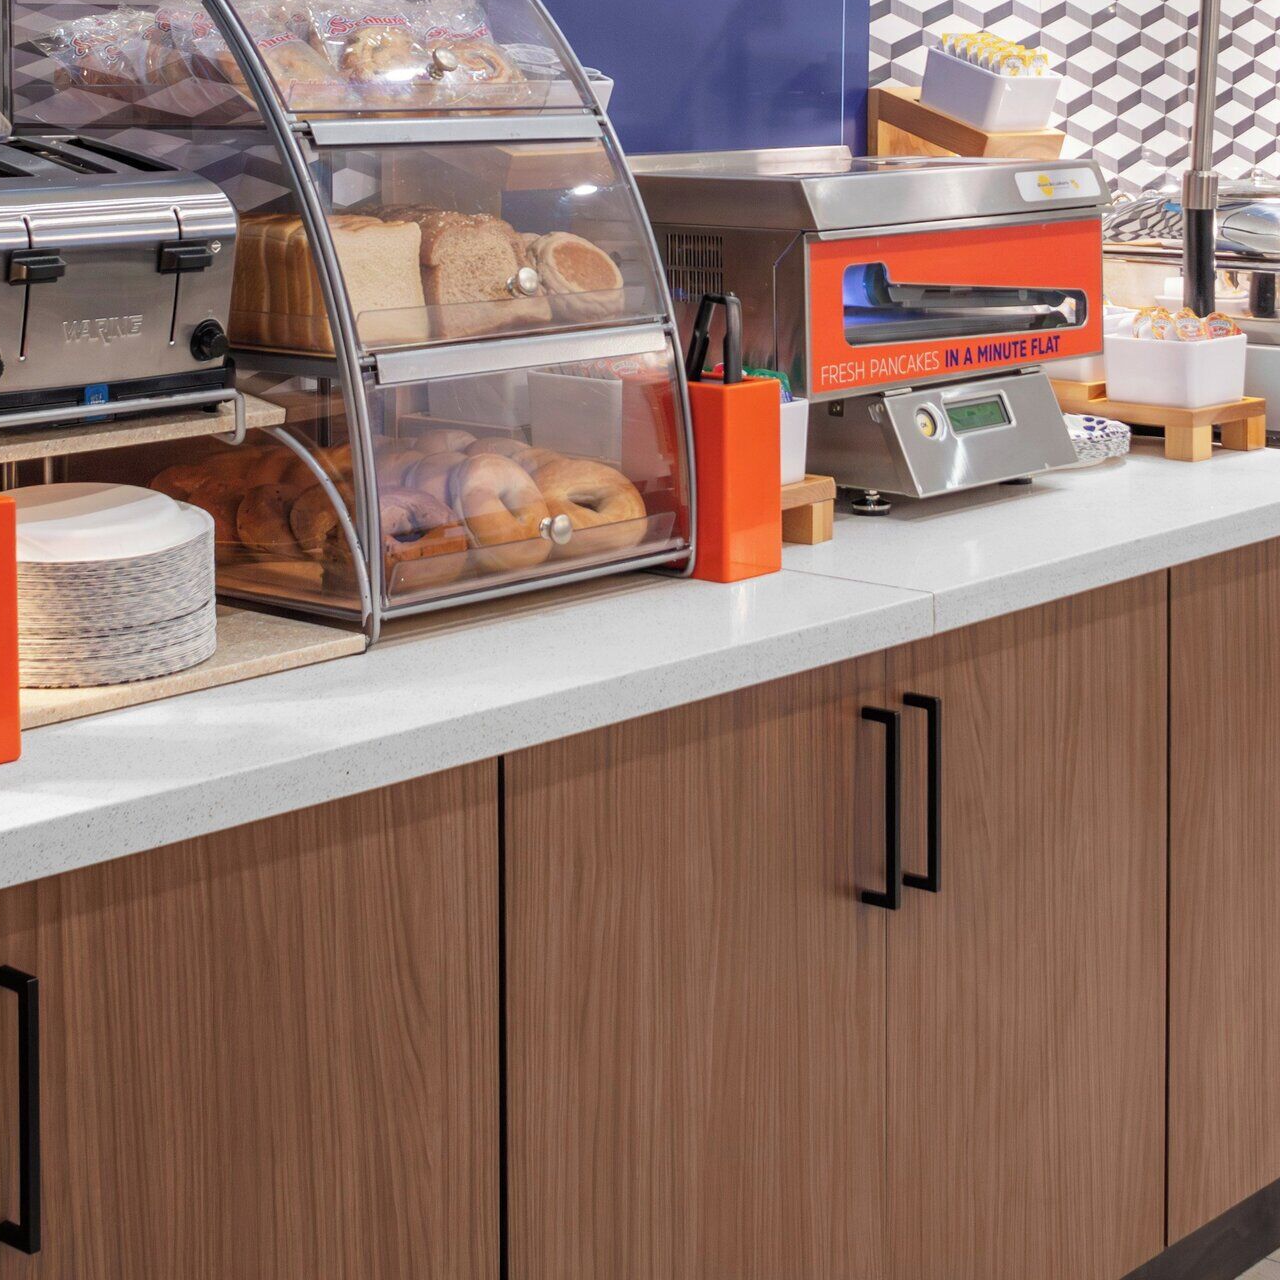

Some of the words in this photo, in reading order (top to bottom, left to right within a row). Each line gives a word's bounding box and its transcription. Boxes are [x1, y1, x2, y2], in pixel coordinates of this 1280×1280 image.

[821, 361, 865, 386] FRESH
[870, 351, 940, 378] PANCAKES
[945, 348, 959, 368] IN
[963, 347, 973, 365] A
[977, 339, 1027, 363] MINUTE
[1031, 335, 1061, 357] FLAT
